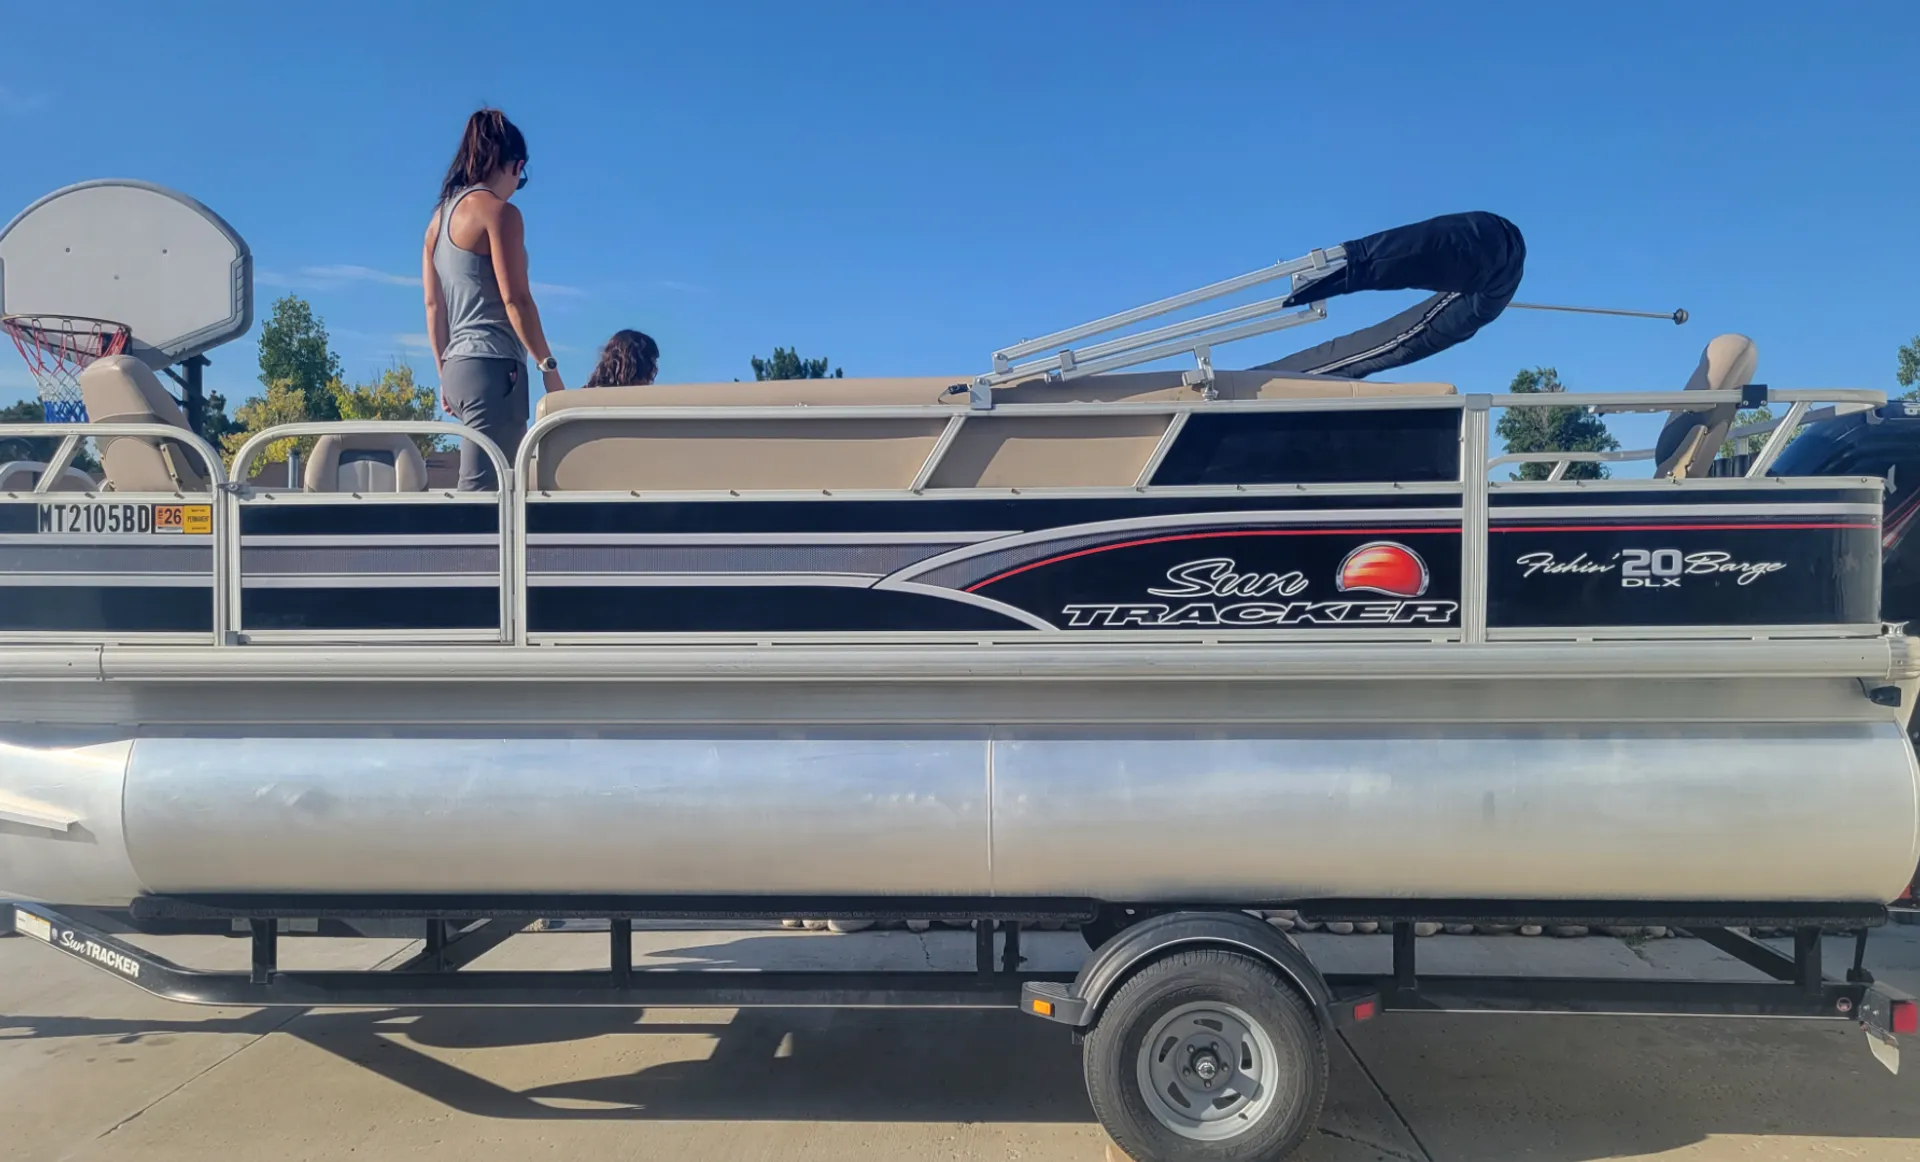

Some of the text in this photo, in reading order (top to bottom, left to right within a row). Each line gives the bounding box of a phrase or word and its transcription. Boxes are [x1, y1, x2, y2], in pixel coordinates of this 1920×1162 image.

[40, 504, 150, 533] MT2105BD
[164, 508, 181, 524] 26
[1147, 558, 1308, 597] Sun
[1516, 549, 1787, 585] Fishin' 20 Barge
[1621, 578, 1682, 587] DLX
[1062, 601, 1458, 626] TRACKER
[59, 930, 140, 978] Sun TRACKER
